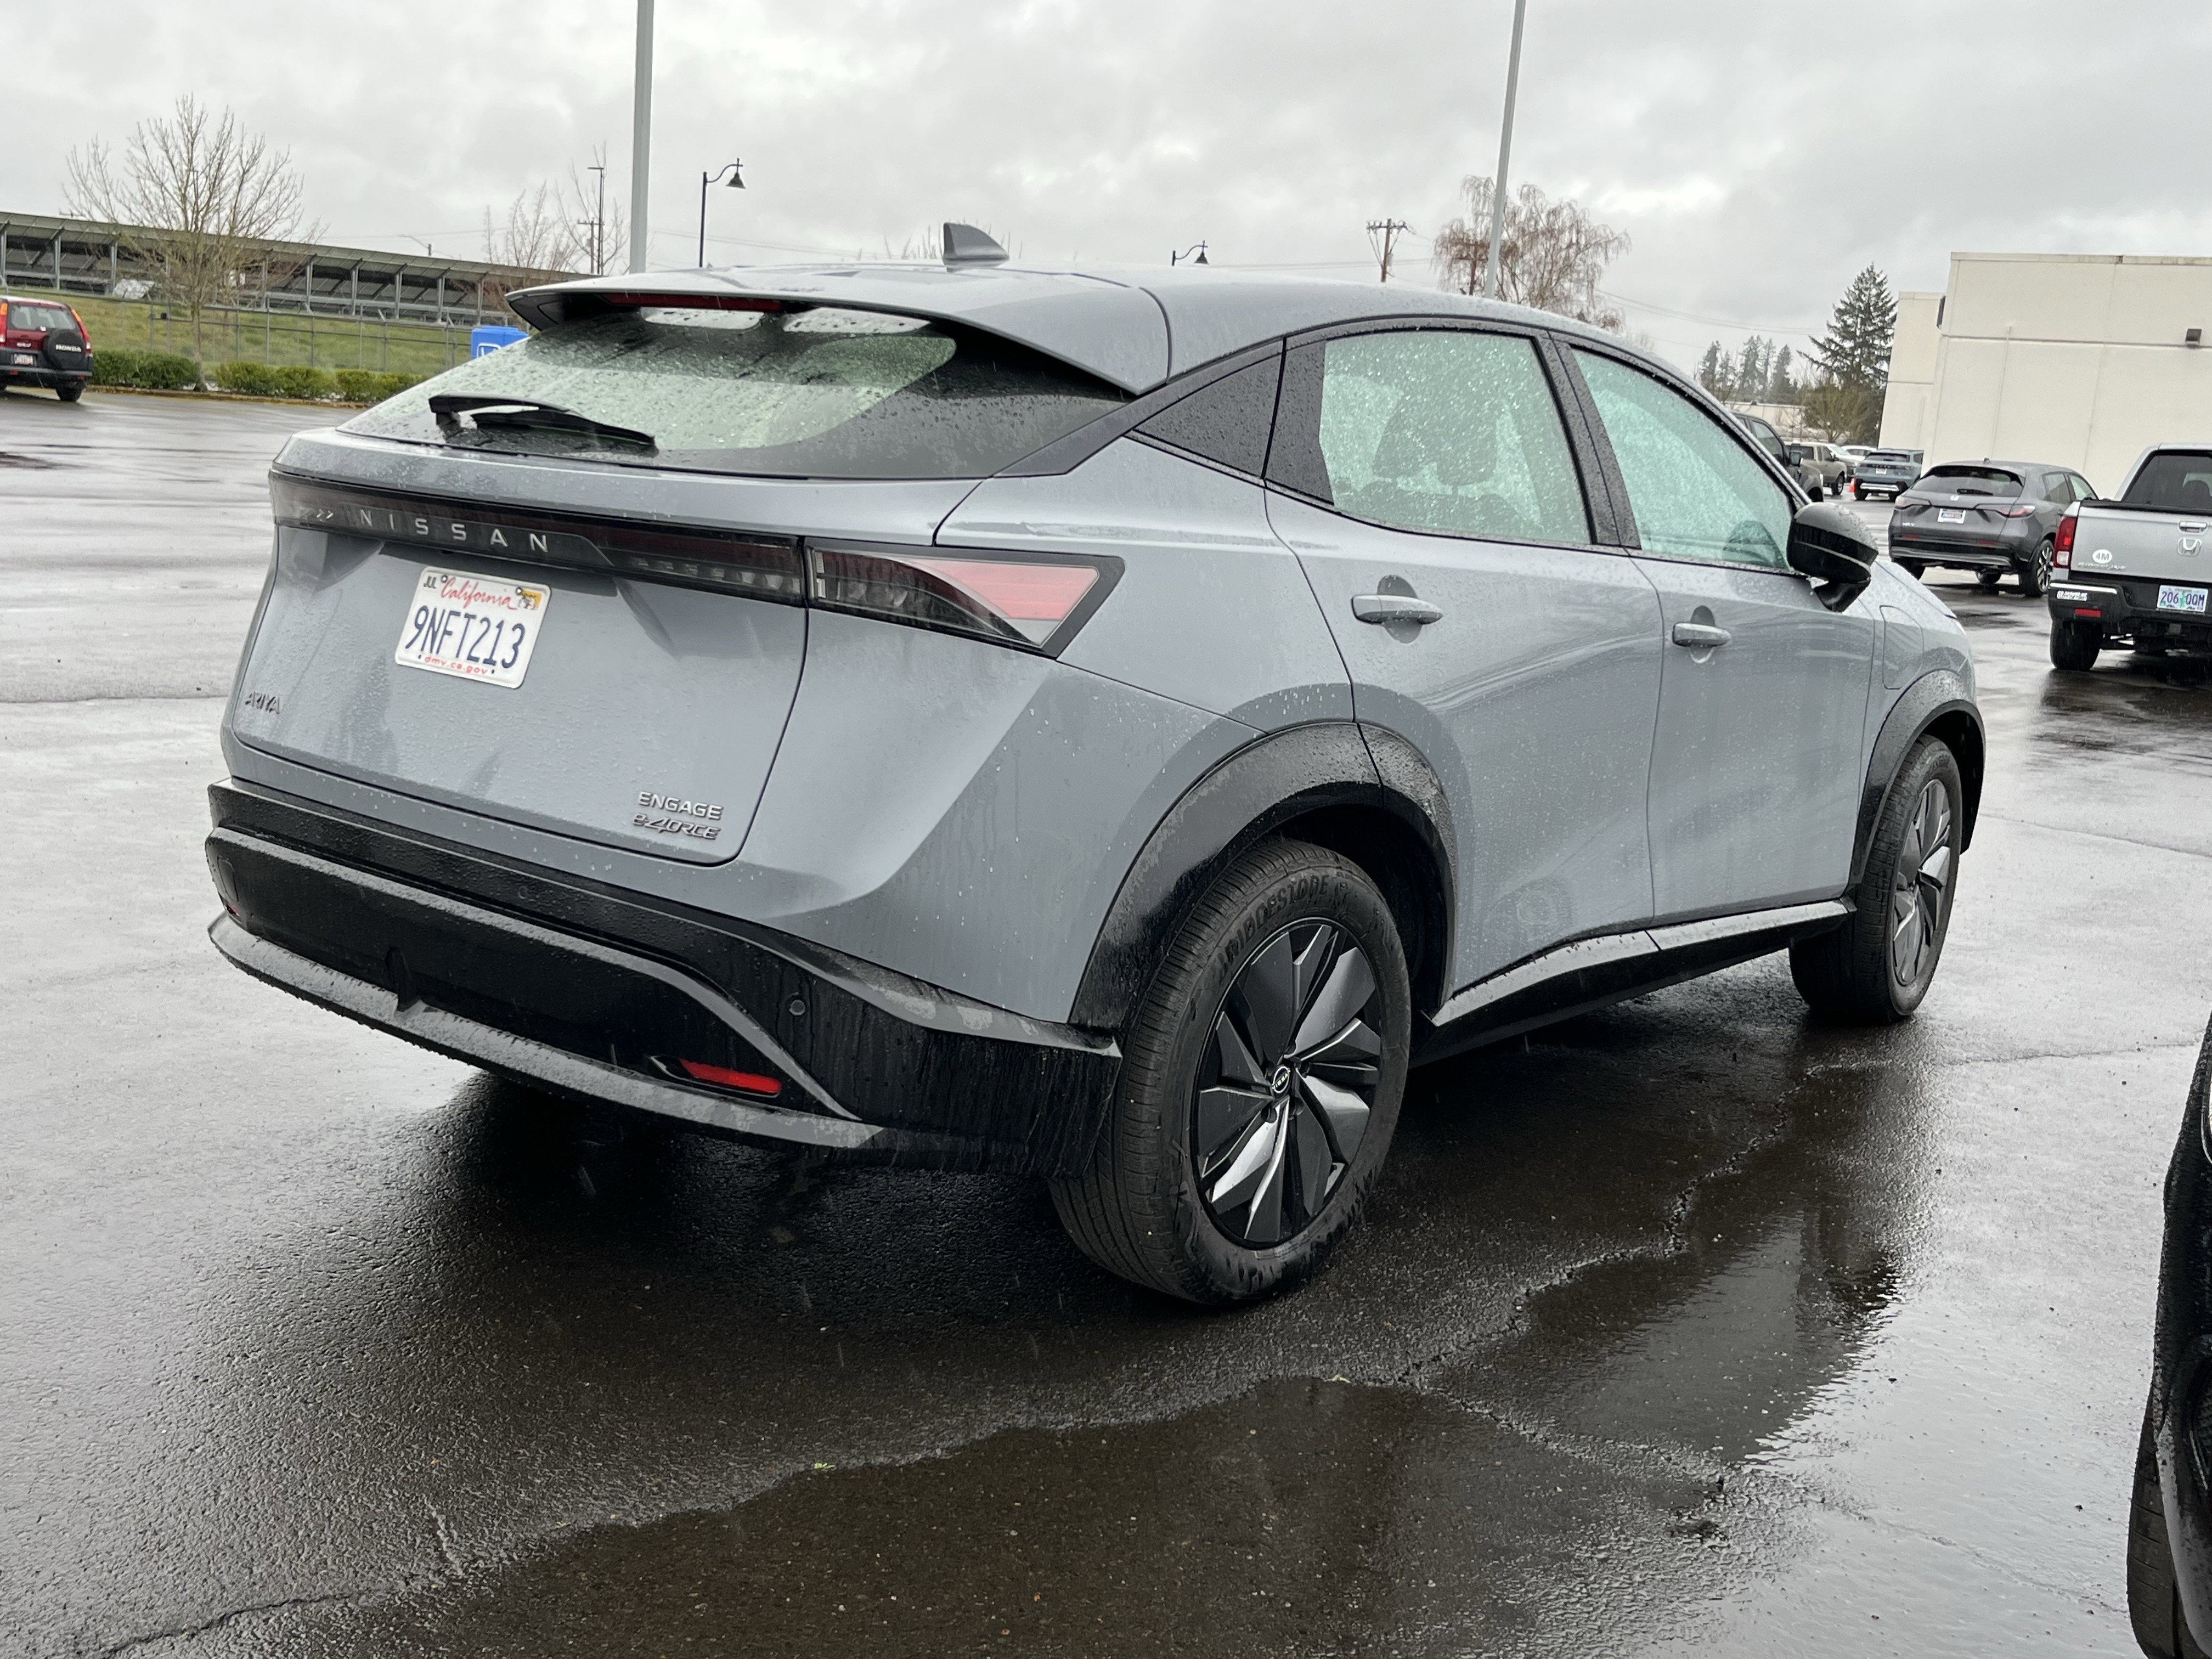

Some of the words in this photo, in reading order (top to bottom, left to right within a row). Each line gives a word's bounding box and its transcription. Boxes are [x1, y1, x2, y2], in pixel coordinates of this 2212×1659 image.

[360, 509, 548, 553] NISSAN
[441, 575, 518, 610] California
[2161, 591, 2179, 604] 206
[405, 605, 526, 669] 9NFT213
[424, 656, 488, 675] dmv.ca.gov
[637, 791, 724, 821] ENGAGE
